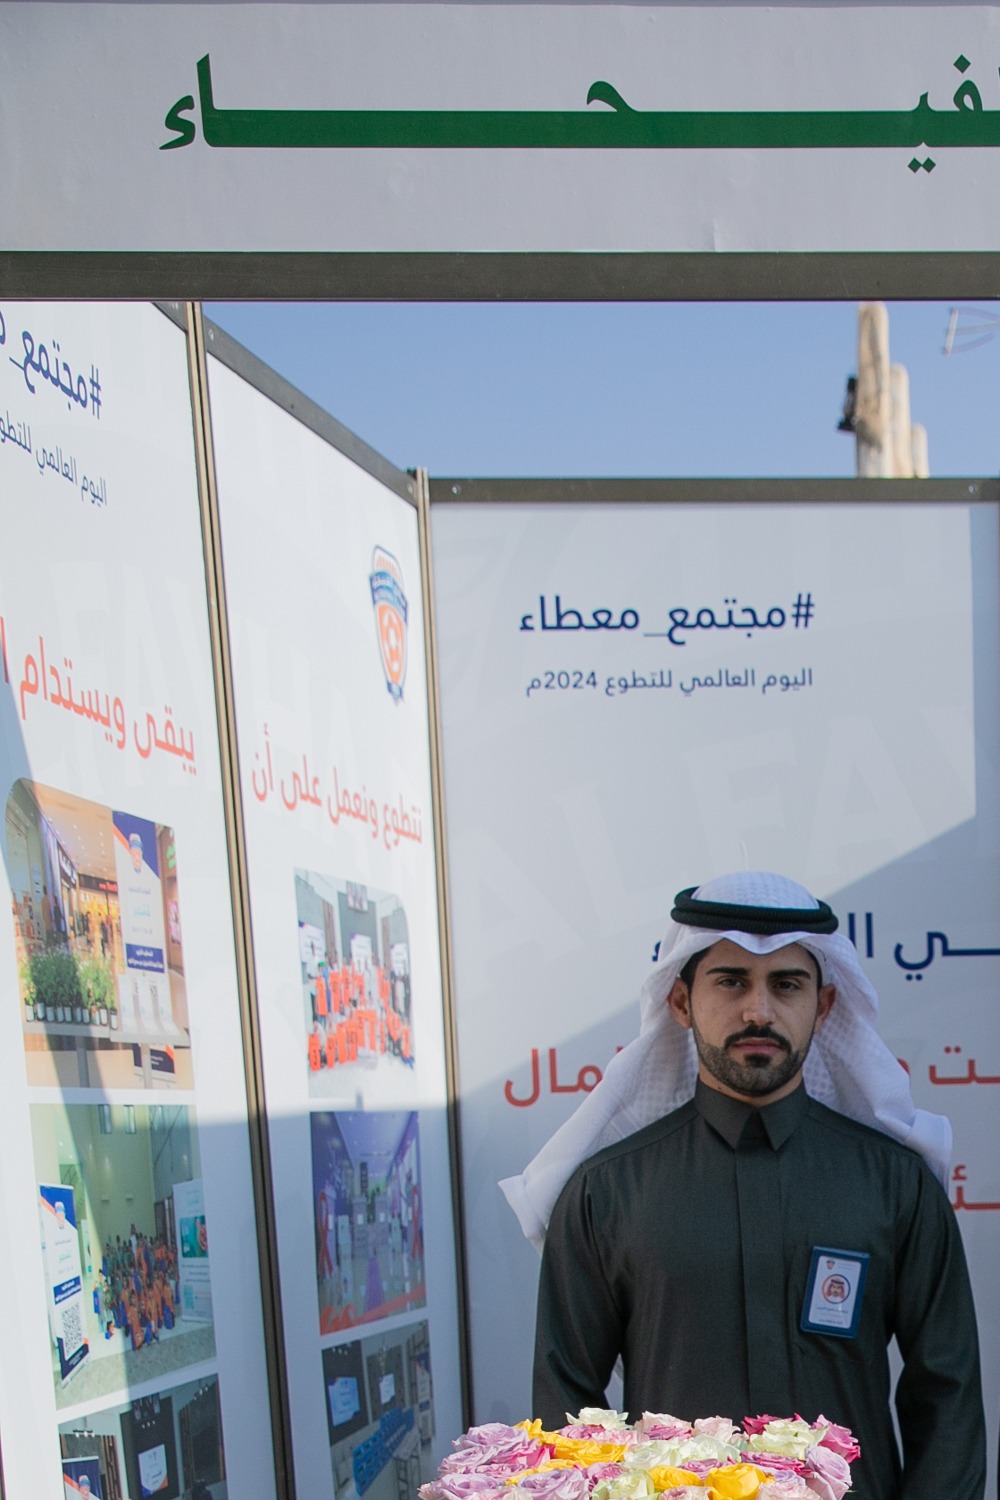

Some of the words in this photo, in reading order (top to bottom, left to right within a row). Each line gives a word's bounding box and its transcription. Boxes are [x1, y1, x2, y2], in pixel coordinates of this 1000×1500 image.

[35, 446, 78, 486] العالمي
[80, 475, 107, 508] اليوم
[520, 593, 815, 645] #مجتمع_معطاء
[20, 635, 126, 750] ويستدام
[526, 670, 598, 698] 2024م
[605, 669, 672, 697] للتطوع
[680, 669, 756, 697] العالمي
[762, 668, 813, 694] اليوم
[133, 704, 197, 776] يبقى
[252, 723, 274, 803] أن
[281, 754, 322, 812] على
[328, 766, 378, 839] ونعمل
[384, 793, 422, 851] نتطوع
